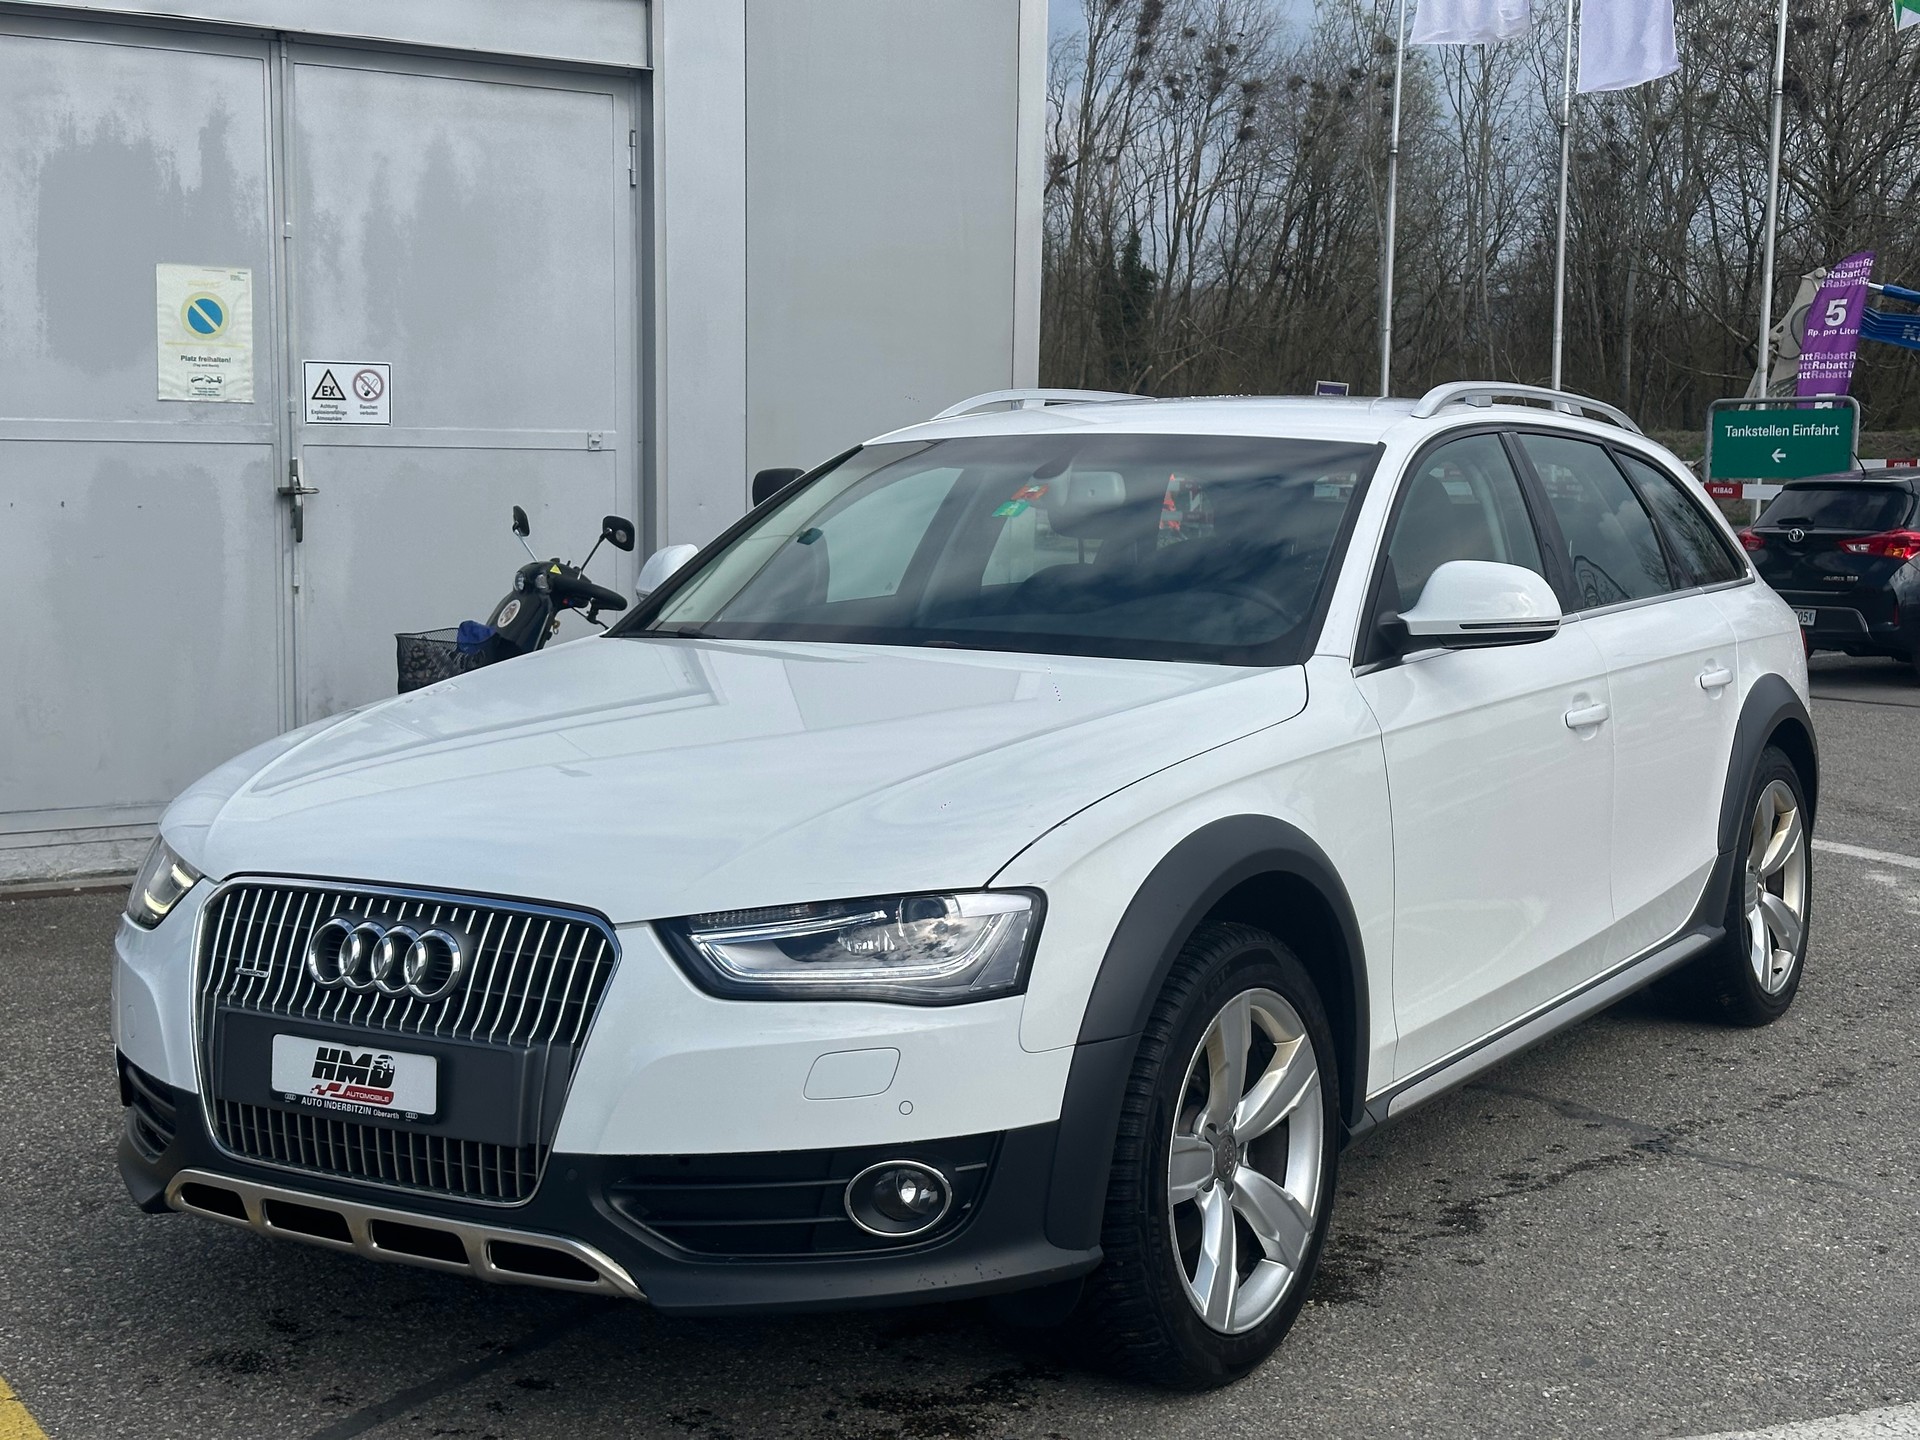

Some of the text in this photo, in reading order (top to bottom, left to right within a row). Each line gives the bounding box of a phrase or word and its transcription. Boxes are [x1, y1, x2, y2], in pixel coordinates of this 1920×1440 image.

[1824, 299, 1848, 326] 5
[1807, 329, 1821, 337] Rp.
[1839, 327, 1859, 335] Liter
[321, 386, 336, 397] EX
[1725, 424, 1840, 438] Tankstellen Einfahrt
[346, 1090, 390, 1103] AUTOMOBILE
[301, 1096, 400, 1120] AUTO INDERBITZIN Oberarth
